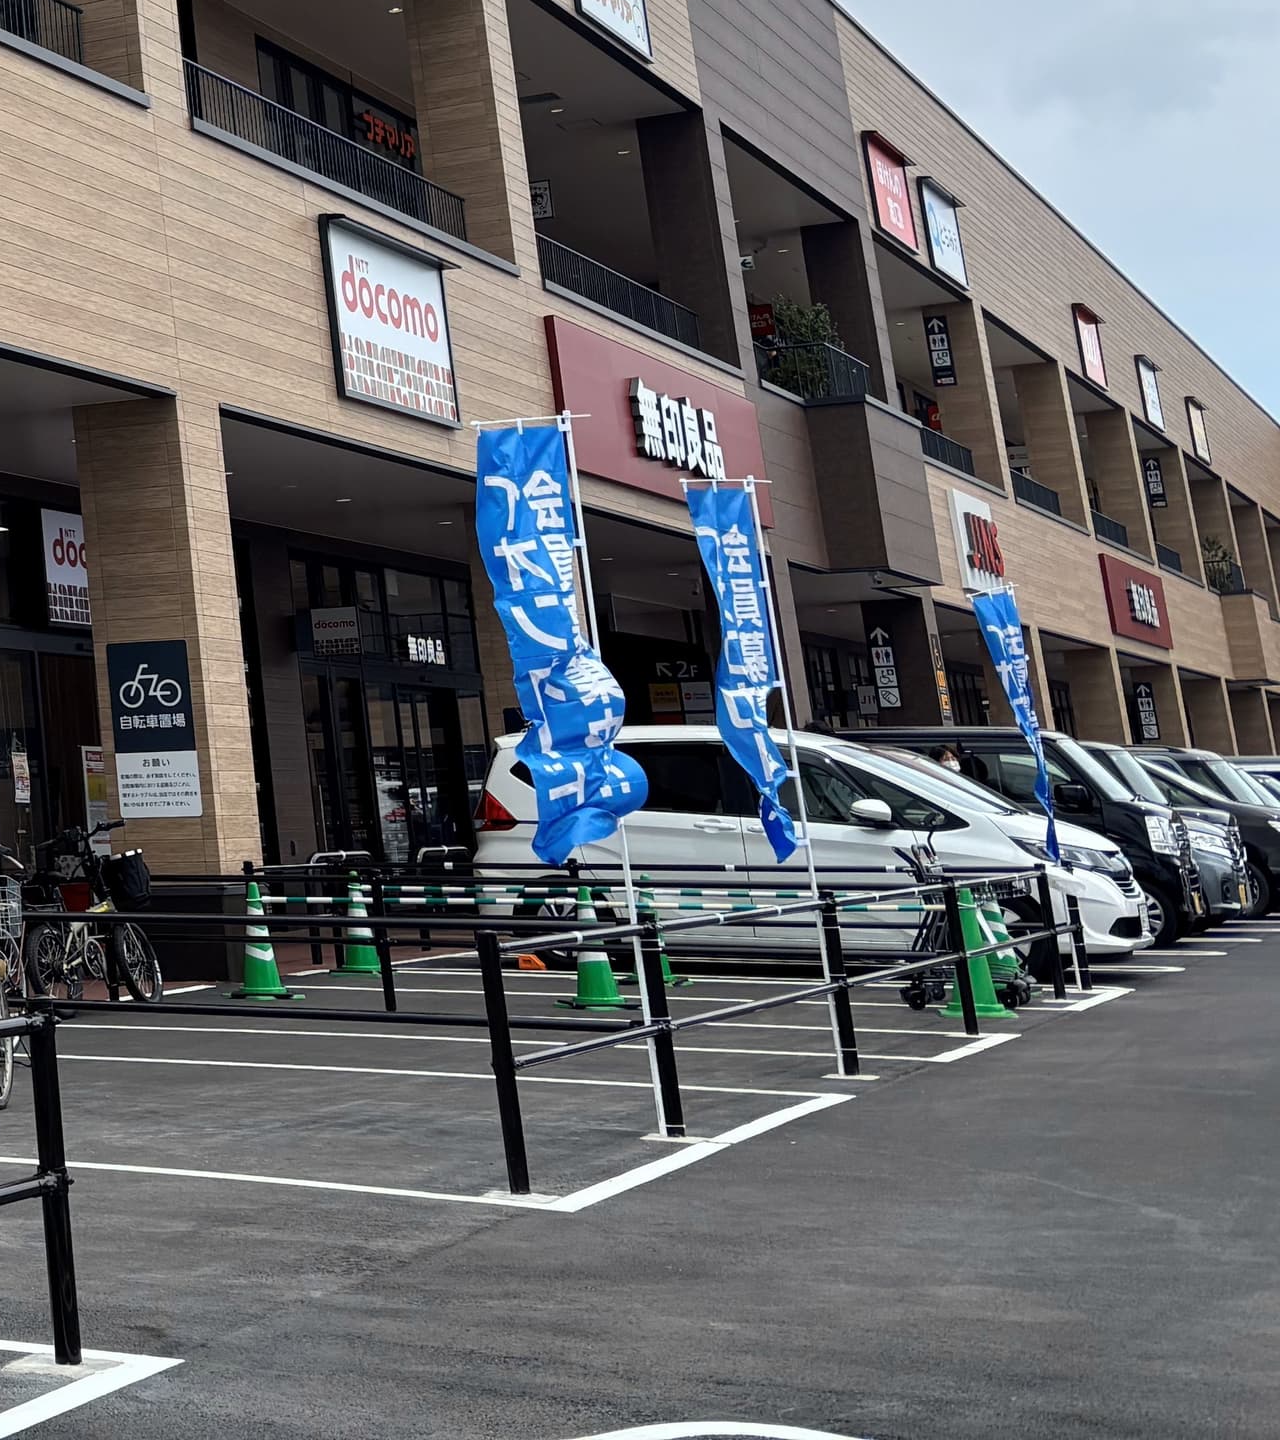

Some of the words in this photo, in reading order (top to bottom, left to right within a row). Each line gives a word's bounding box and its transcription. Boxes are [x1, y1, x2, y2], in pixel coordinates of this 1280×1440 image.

[341, 254, 438, 343] docomo
[636, 376, 726, 481] 無印良品
[53, 527, 88, 569] doc
[313, 618, 356, 630] docomo
[407, 633, 446, 665] 無印良品
[676, 660, 699, 678] 2F
[119, 712, 186, 730] 自転車置場
[142, 758, 170, 767] お願い
